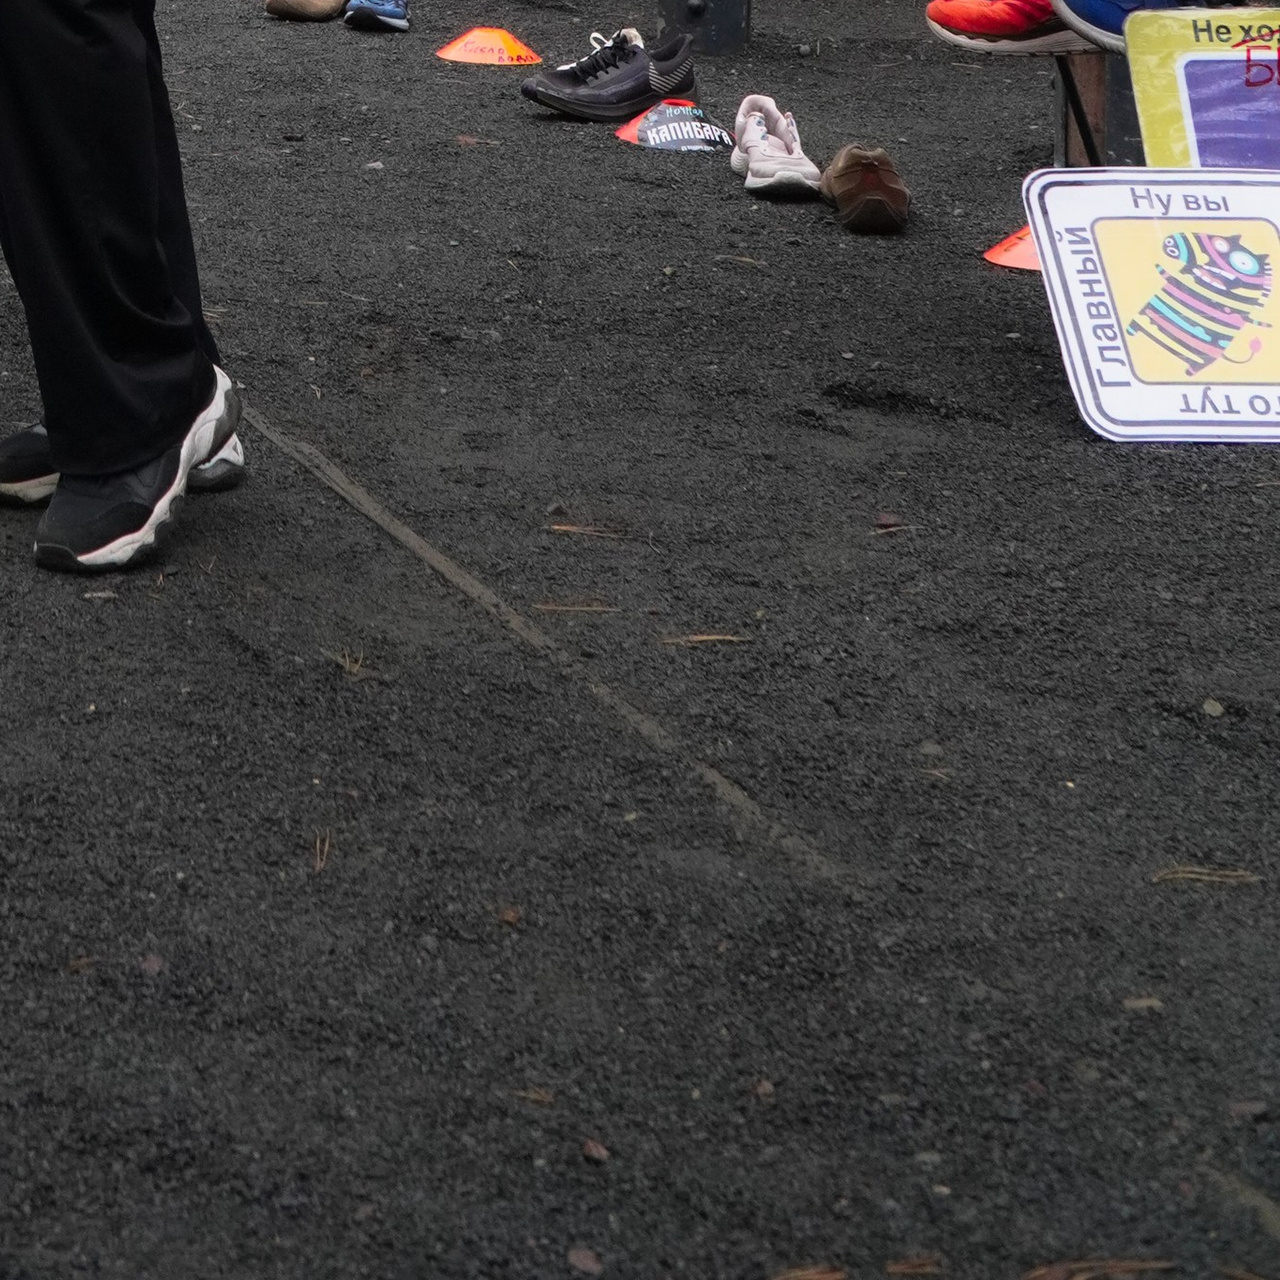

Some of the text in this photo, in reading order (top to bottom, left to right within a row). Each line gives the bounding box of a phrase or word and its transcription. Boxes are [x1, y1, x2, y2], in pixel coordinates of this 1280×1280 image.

[1192, 19, 1280, 46] Не хо
[1130, 187, 1231, 215] Ну вы
[1055, 226, 1132, 388] Главный
[1179, 386, 1241, 415] тут
